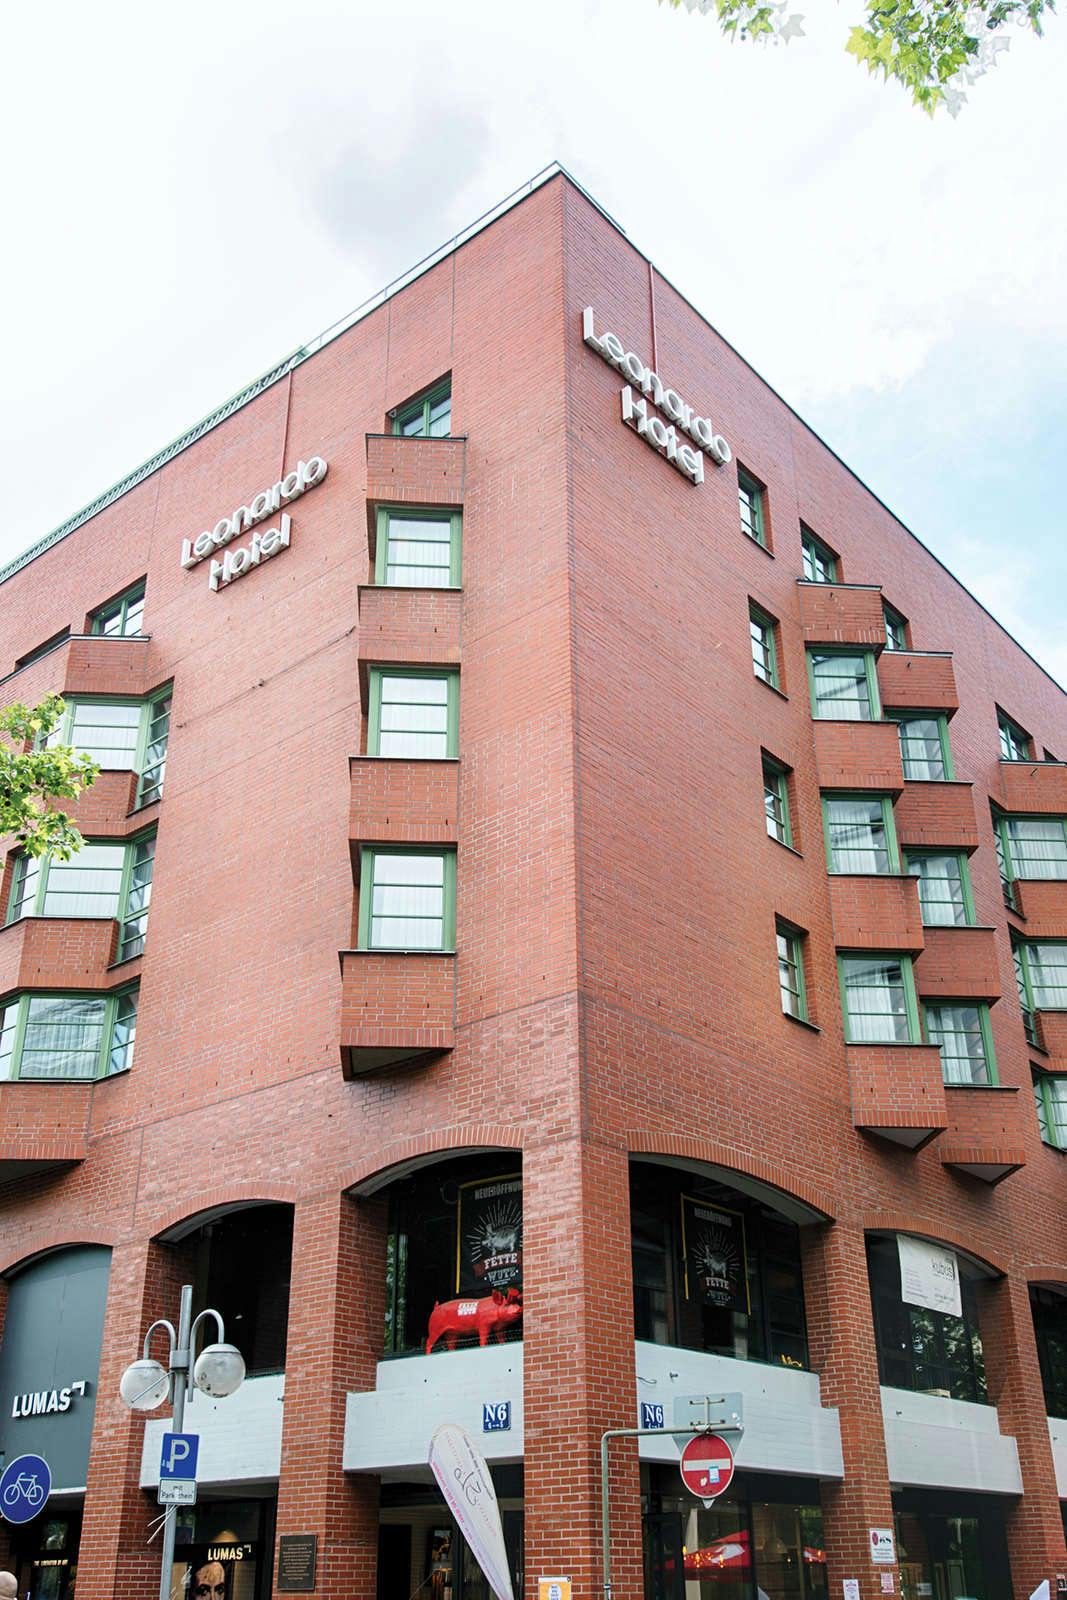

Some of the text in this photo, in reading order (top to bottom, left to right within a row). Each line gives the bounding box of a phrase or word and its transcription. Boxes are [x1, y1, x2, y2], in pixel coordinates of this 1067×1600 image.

[583, 306, 732, 466] Leonardo
[621, 384, 704, 487] Hotel
[180, 456, 328, 570] Leonardo
[209, 513, 292, 592] Hotel
[484, 1253, 518, 1270] FETTE
[12, 1387, 72, 1417] LUMAS
[485, 1403, 507, 1422] N6
[645, 1404, 663, 1423] N6
[169, 1439, 190, 1472] P
[207, 1546, 243, 1561] LUMAS
